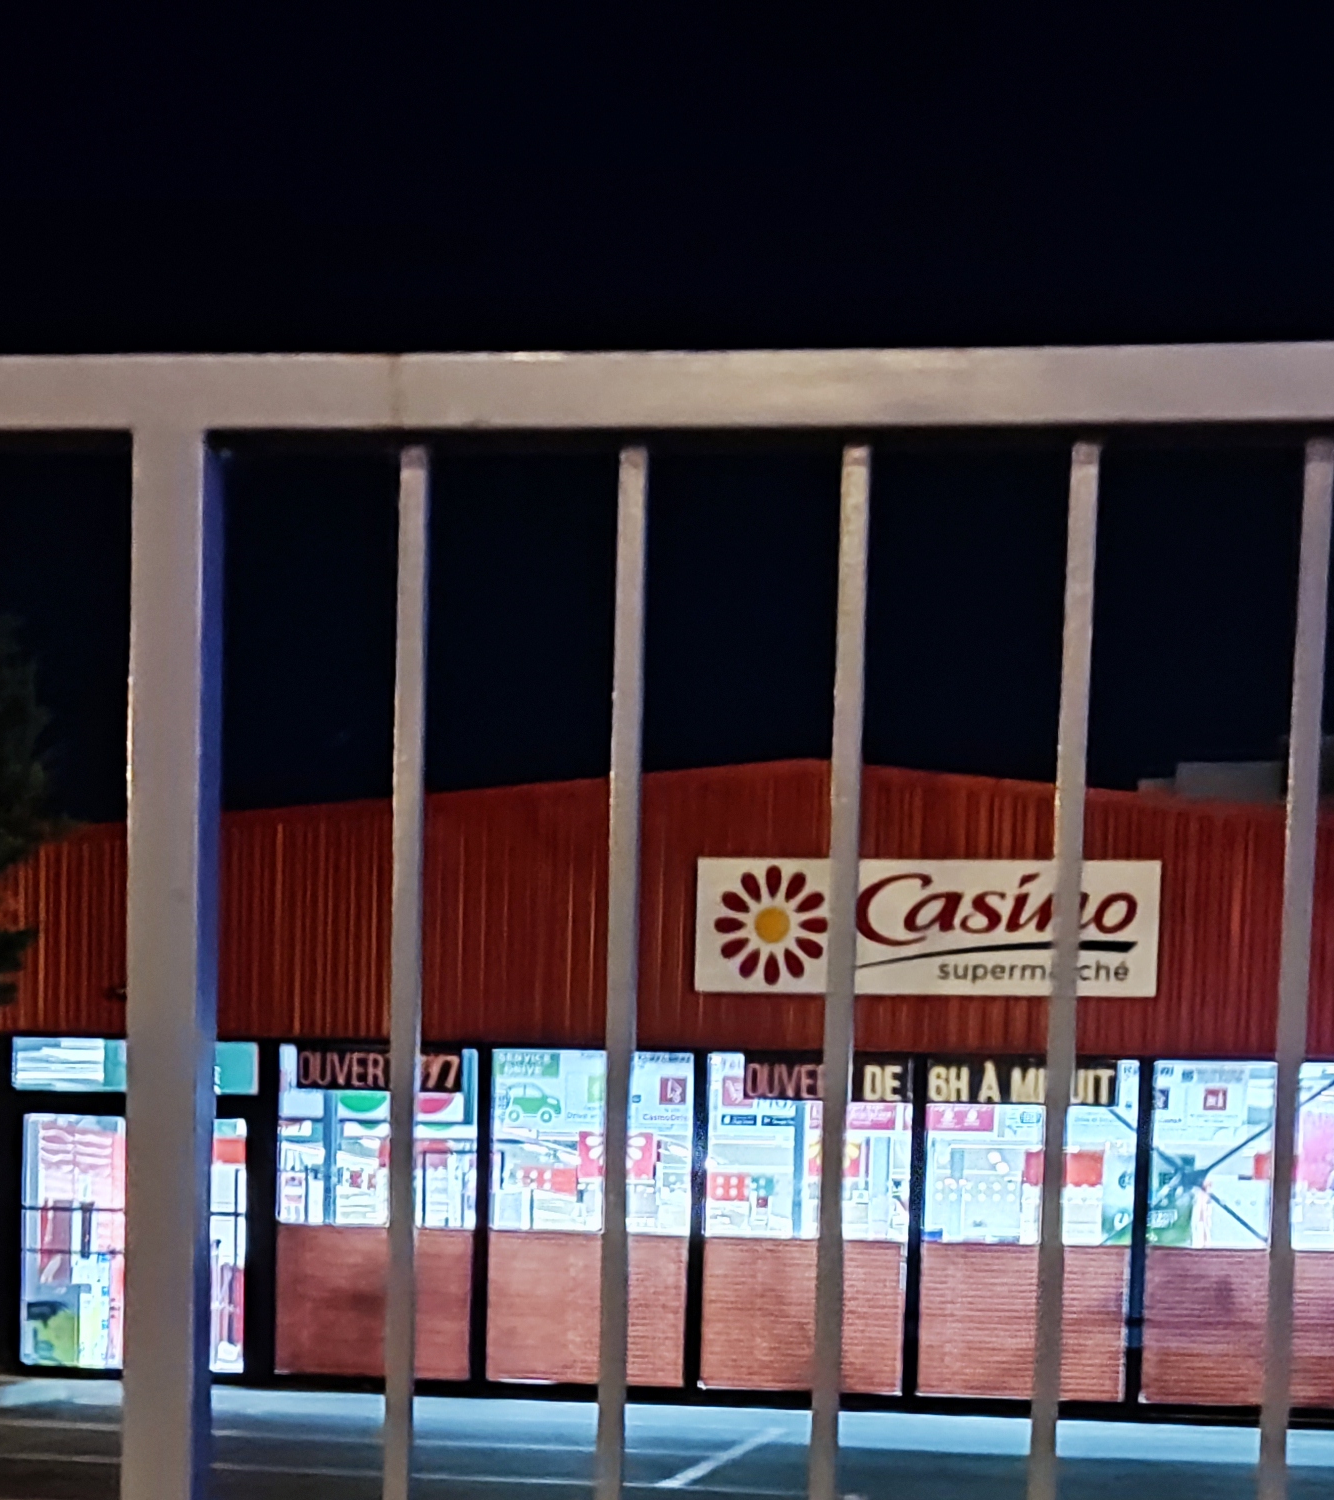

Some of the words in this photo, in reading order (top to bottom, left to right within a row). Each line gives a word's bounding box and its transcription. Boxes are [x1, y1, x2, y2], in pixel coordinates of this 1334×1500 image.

[937, 960, 1130, 984] supermché
[299, 1051, 390, 1088] OUVER
[746, 1062, 825, 1099] OUVE
[862, 1064, 904, 1101] DE
[928, 1064, 970, 1102] 6H
[1010, 1065, 1116, 1105] MIUIT
